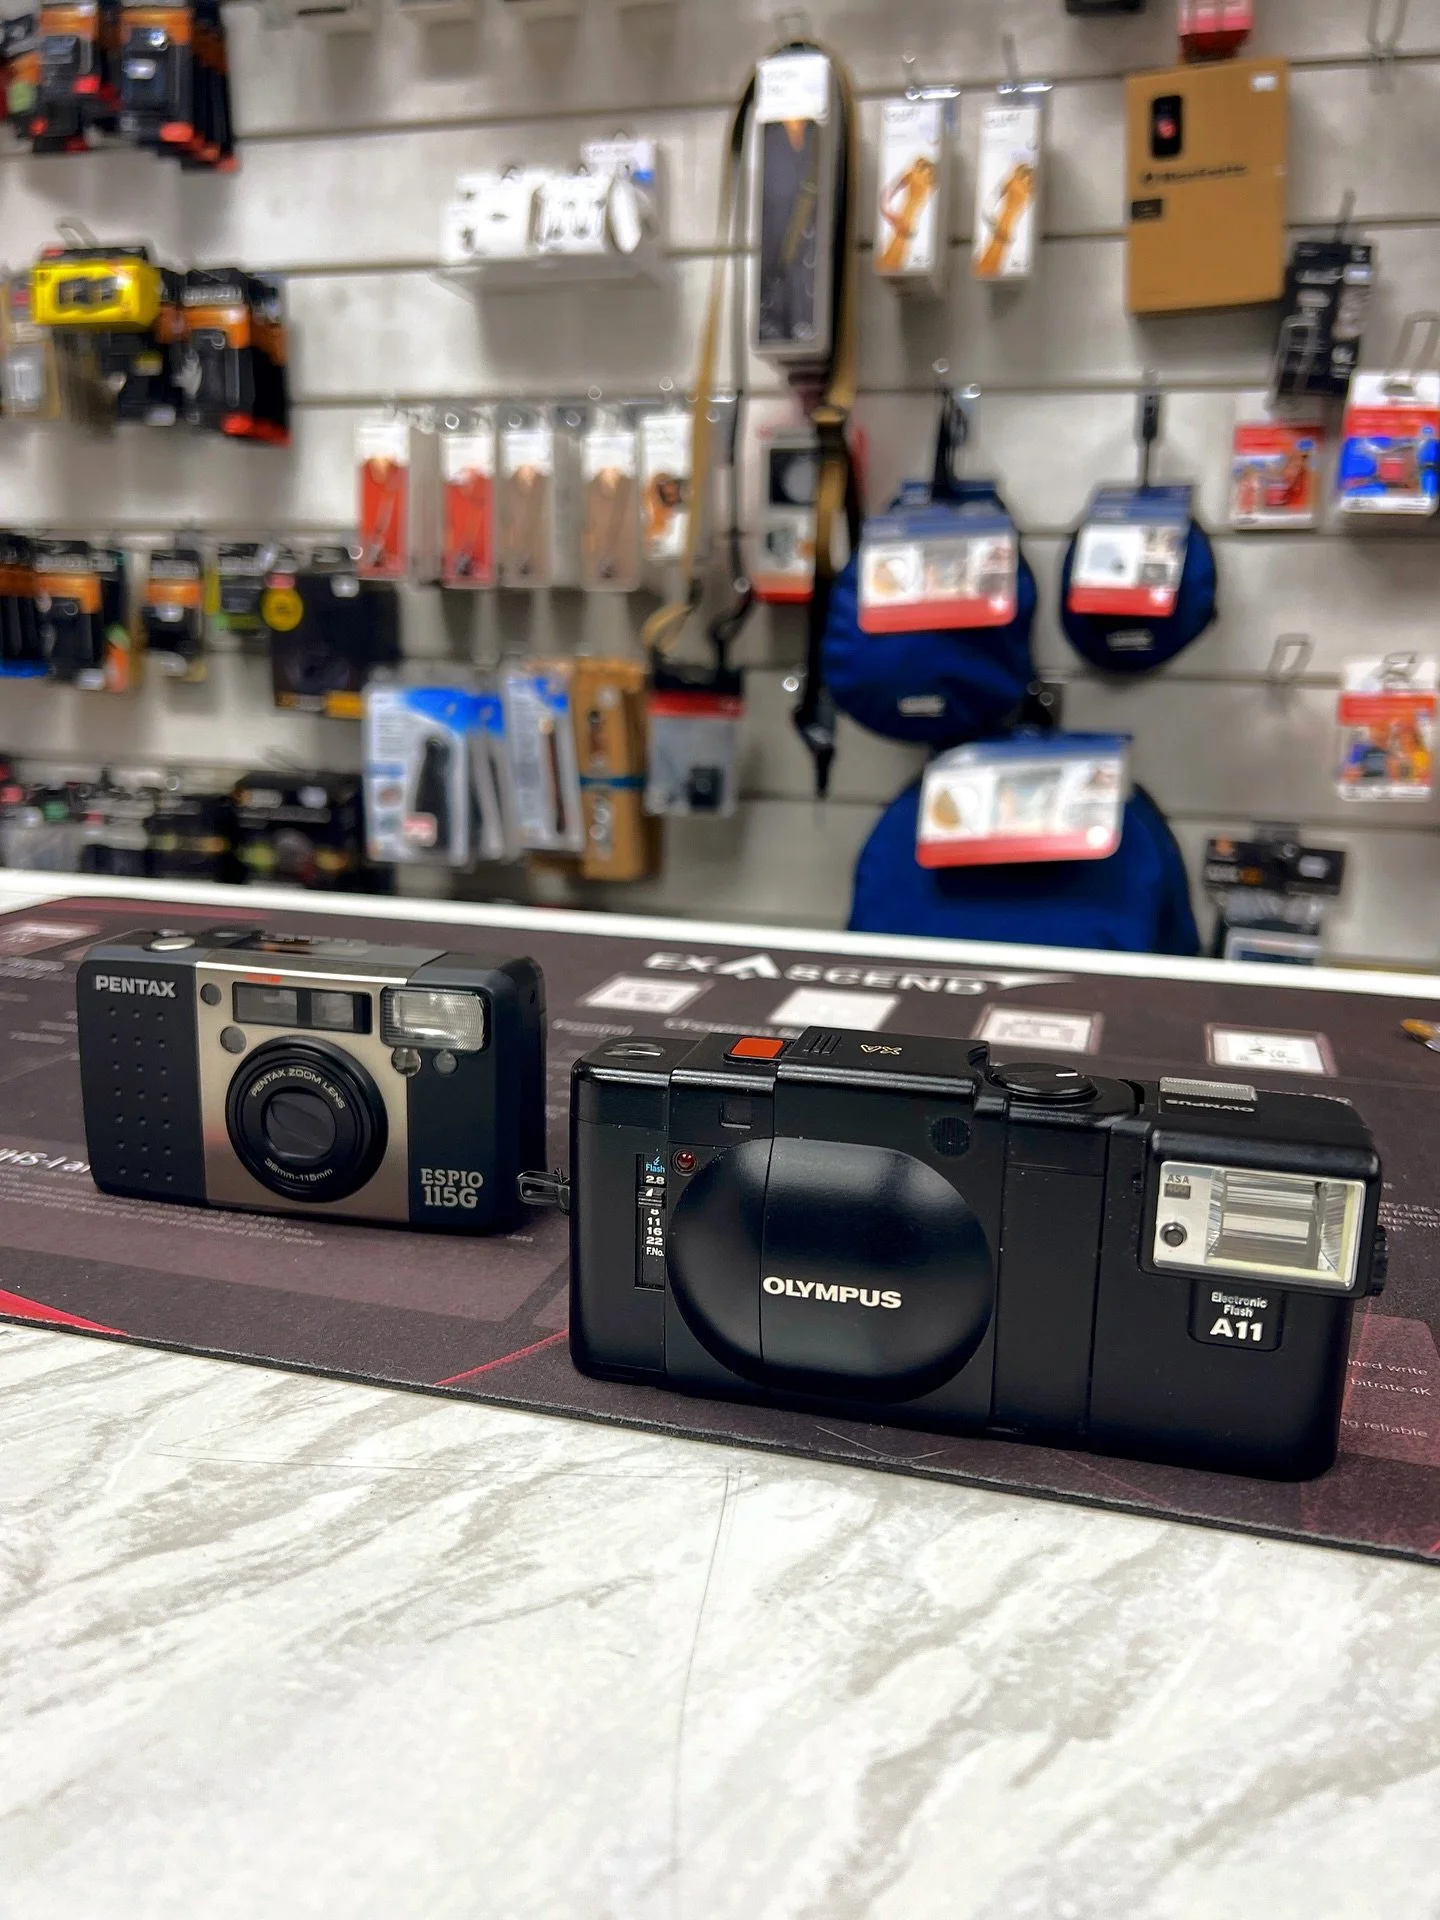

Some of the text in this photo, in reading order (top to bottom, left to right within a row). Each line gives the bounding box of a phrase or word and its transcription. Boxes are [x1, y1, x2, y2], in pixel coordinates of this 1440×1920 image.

[95, 974, 176, 998] PENTAX
[860, 1044, 902, 1055] XA
[250, 1067, 346, 1110] PENTAX ZOOM LENS
[1164, 1099, 1255, 1112] OLYMPUS
[264, 1157, 334, 1182] 38mm-115mm
[645, 1163, 665, 1173] Flash
[420, 1168, 484, 1189] ESPIO
[645, 1175, 665, 1185] 2.8
[1167, 1174, 1190, 1184] ASA
[424, 1185, 478, 1209] 115G
[647, 1216, 662, 1226] 11
[646, 1226, 663, 1236] 16
[645, 1236, 663, 1246] 22
[646, 1246, 665, 1257] F.No.
[762, 1276, 902, 1309] OLYMPUS
[1211, 1291, 1268, 1309] Electronic
[1223, 1304, 1254, 1318] Flash
[1209, 1317, 1264, 1342] A11
[1347, 1358, 1428, 1376] ined write
[1409, 1387, 1432, 1397] 4K
[1363, 1422, 1430, 1438] reliable
